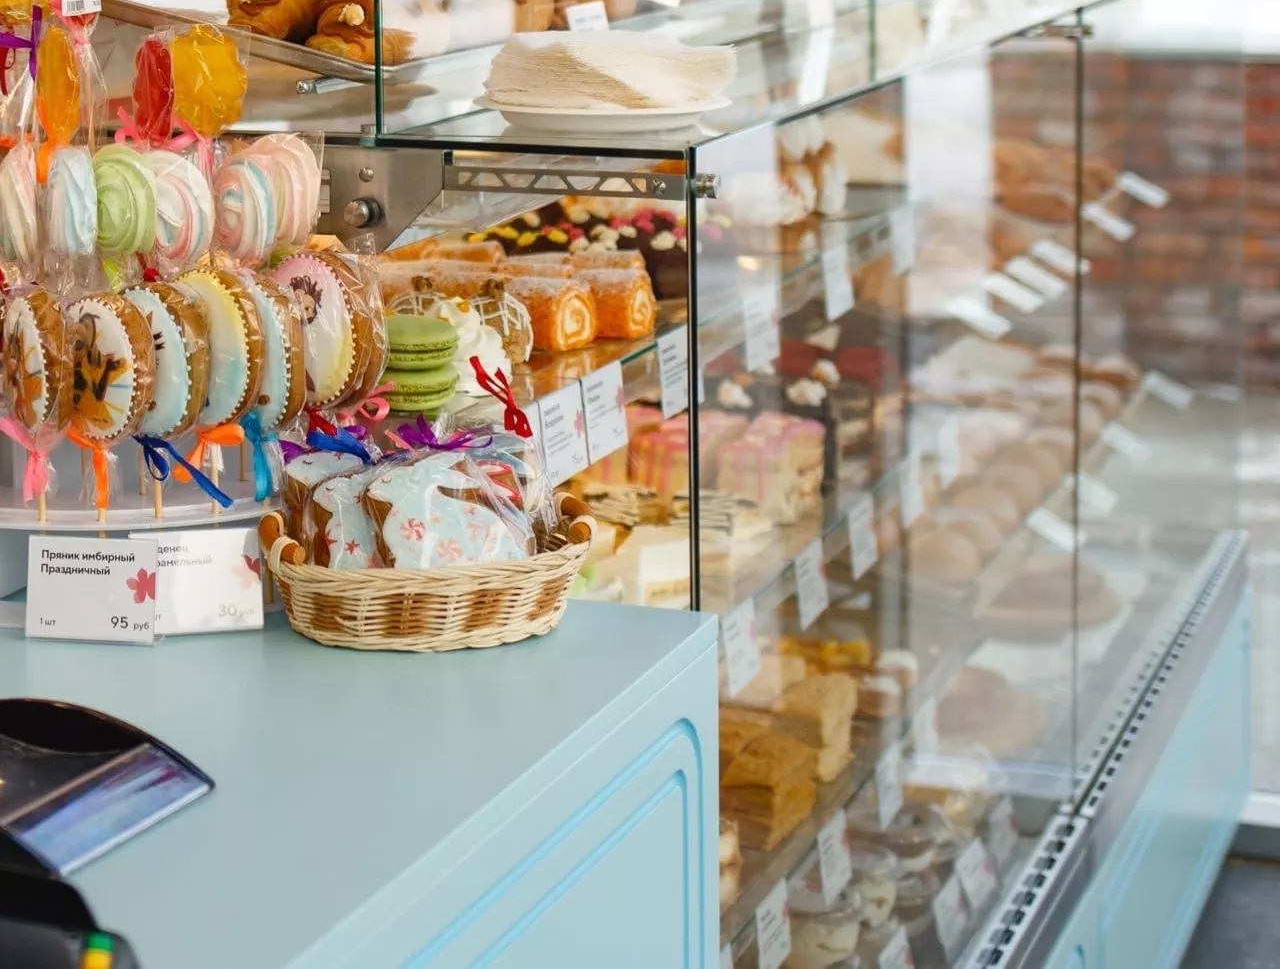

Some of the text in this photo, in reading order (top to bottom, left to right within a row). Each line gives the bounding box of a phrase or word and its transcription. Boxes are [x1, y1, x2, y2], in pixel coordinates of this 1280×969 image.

[41, 549, 136, 564] Пряник имбирный
[157, 544, 190, 555] денец
[157, 554, 213, 568] амельный
[40, 563, 111, 576] Праздничный
[218, 604, 238, 618] 30
[39, 617, 57, 627] 1 шт
[110, 615, 150, 632] 95 руб
